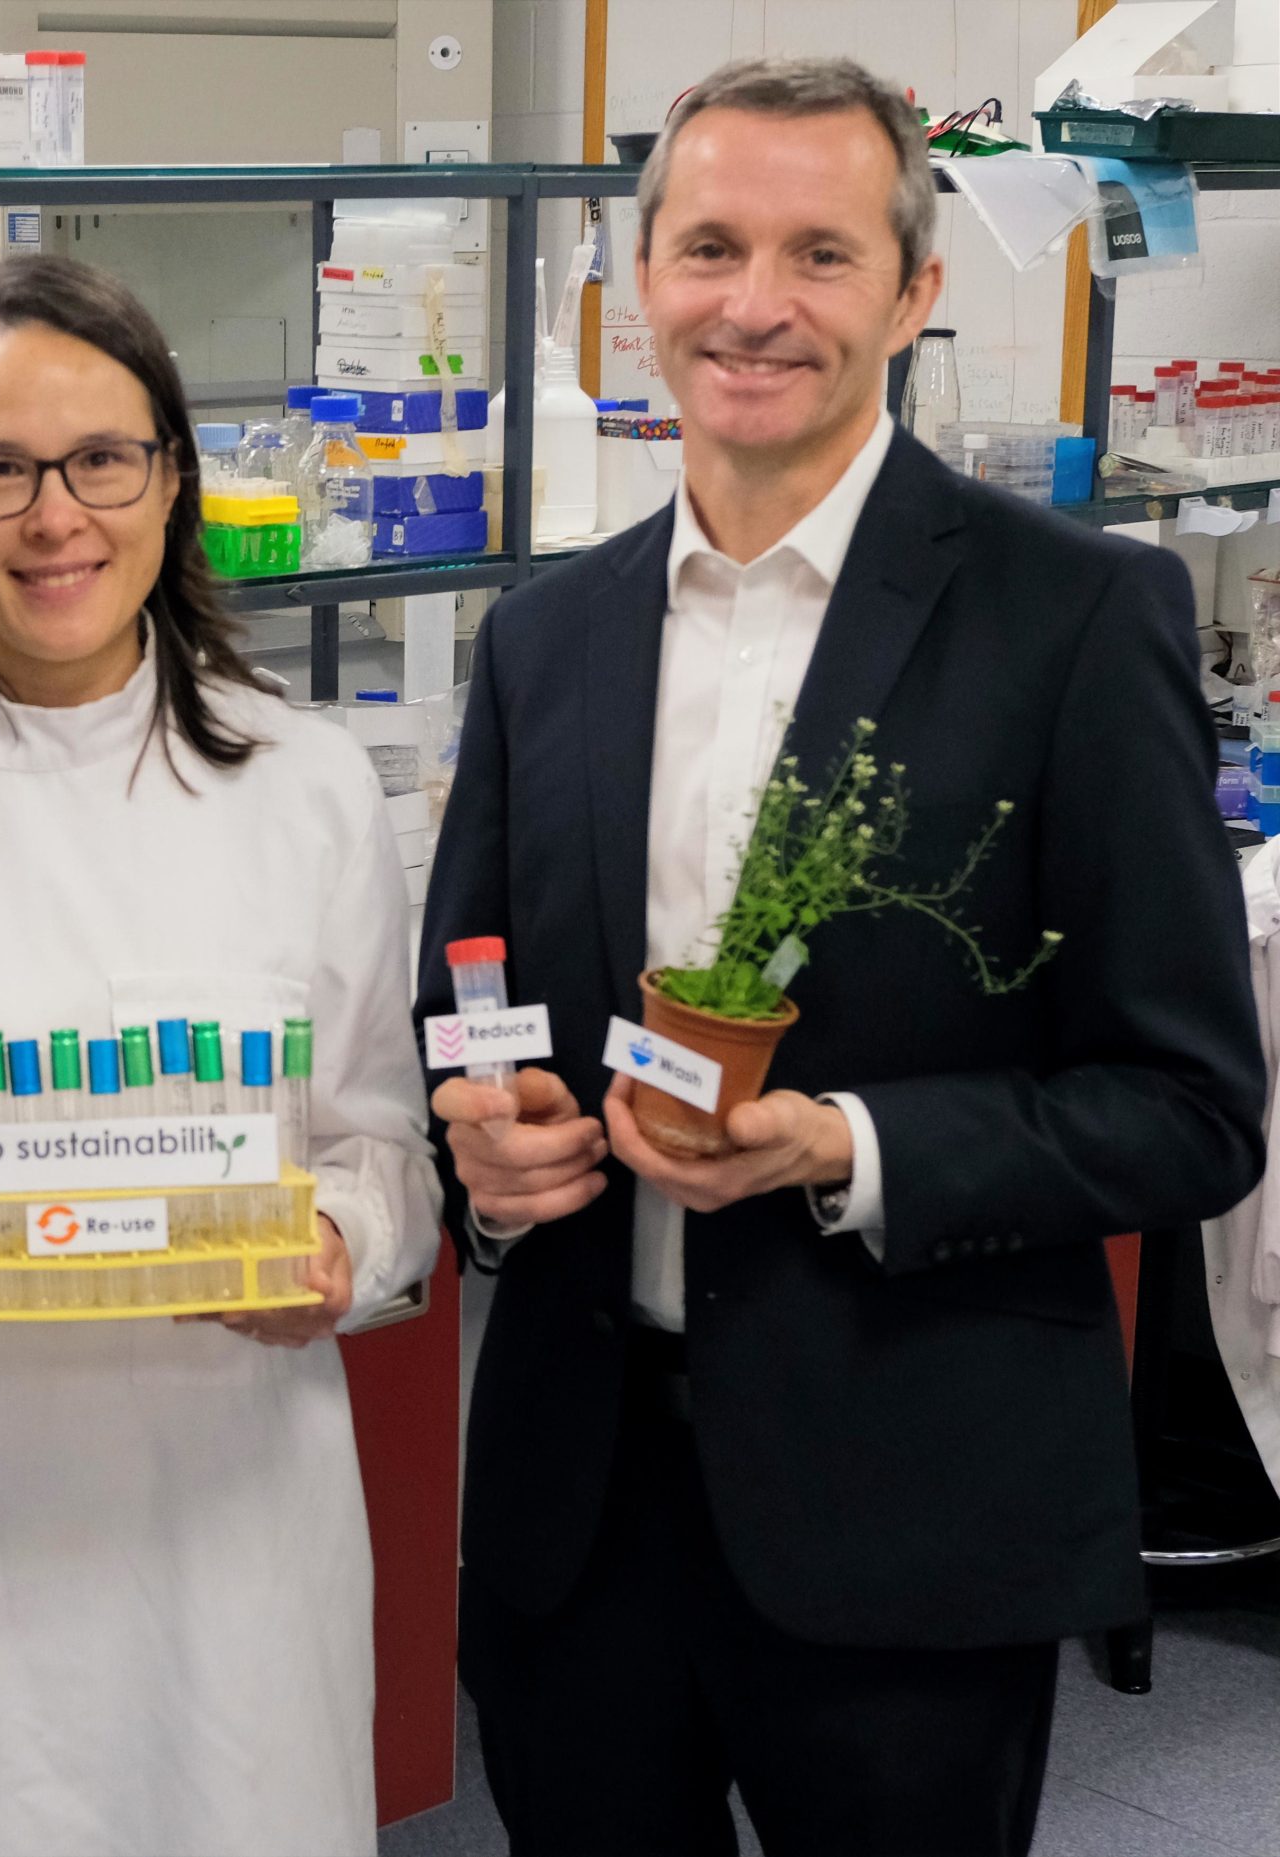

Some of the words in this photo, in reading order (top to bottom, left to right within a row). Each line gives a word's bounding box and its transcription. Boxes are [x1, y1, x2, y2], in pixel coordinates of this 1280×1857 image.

[468, 1022, 536, 1040] Reduce
[660, 1055, 703, 1088] Wash
[86, 1216, 156, 1235] Re-use
